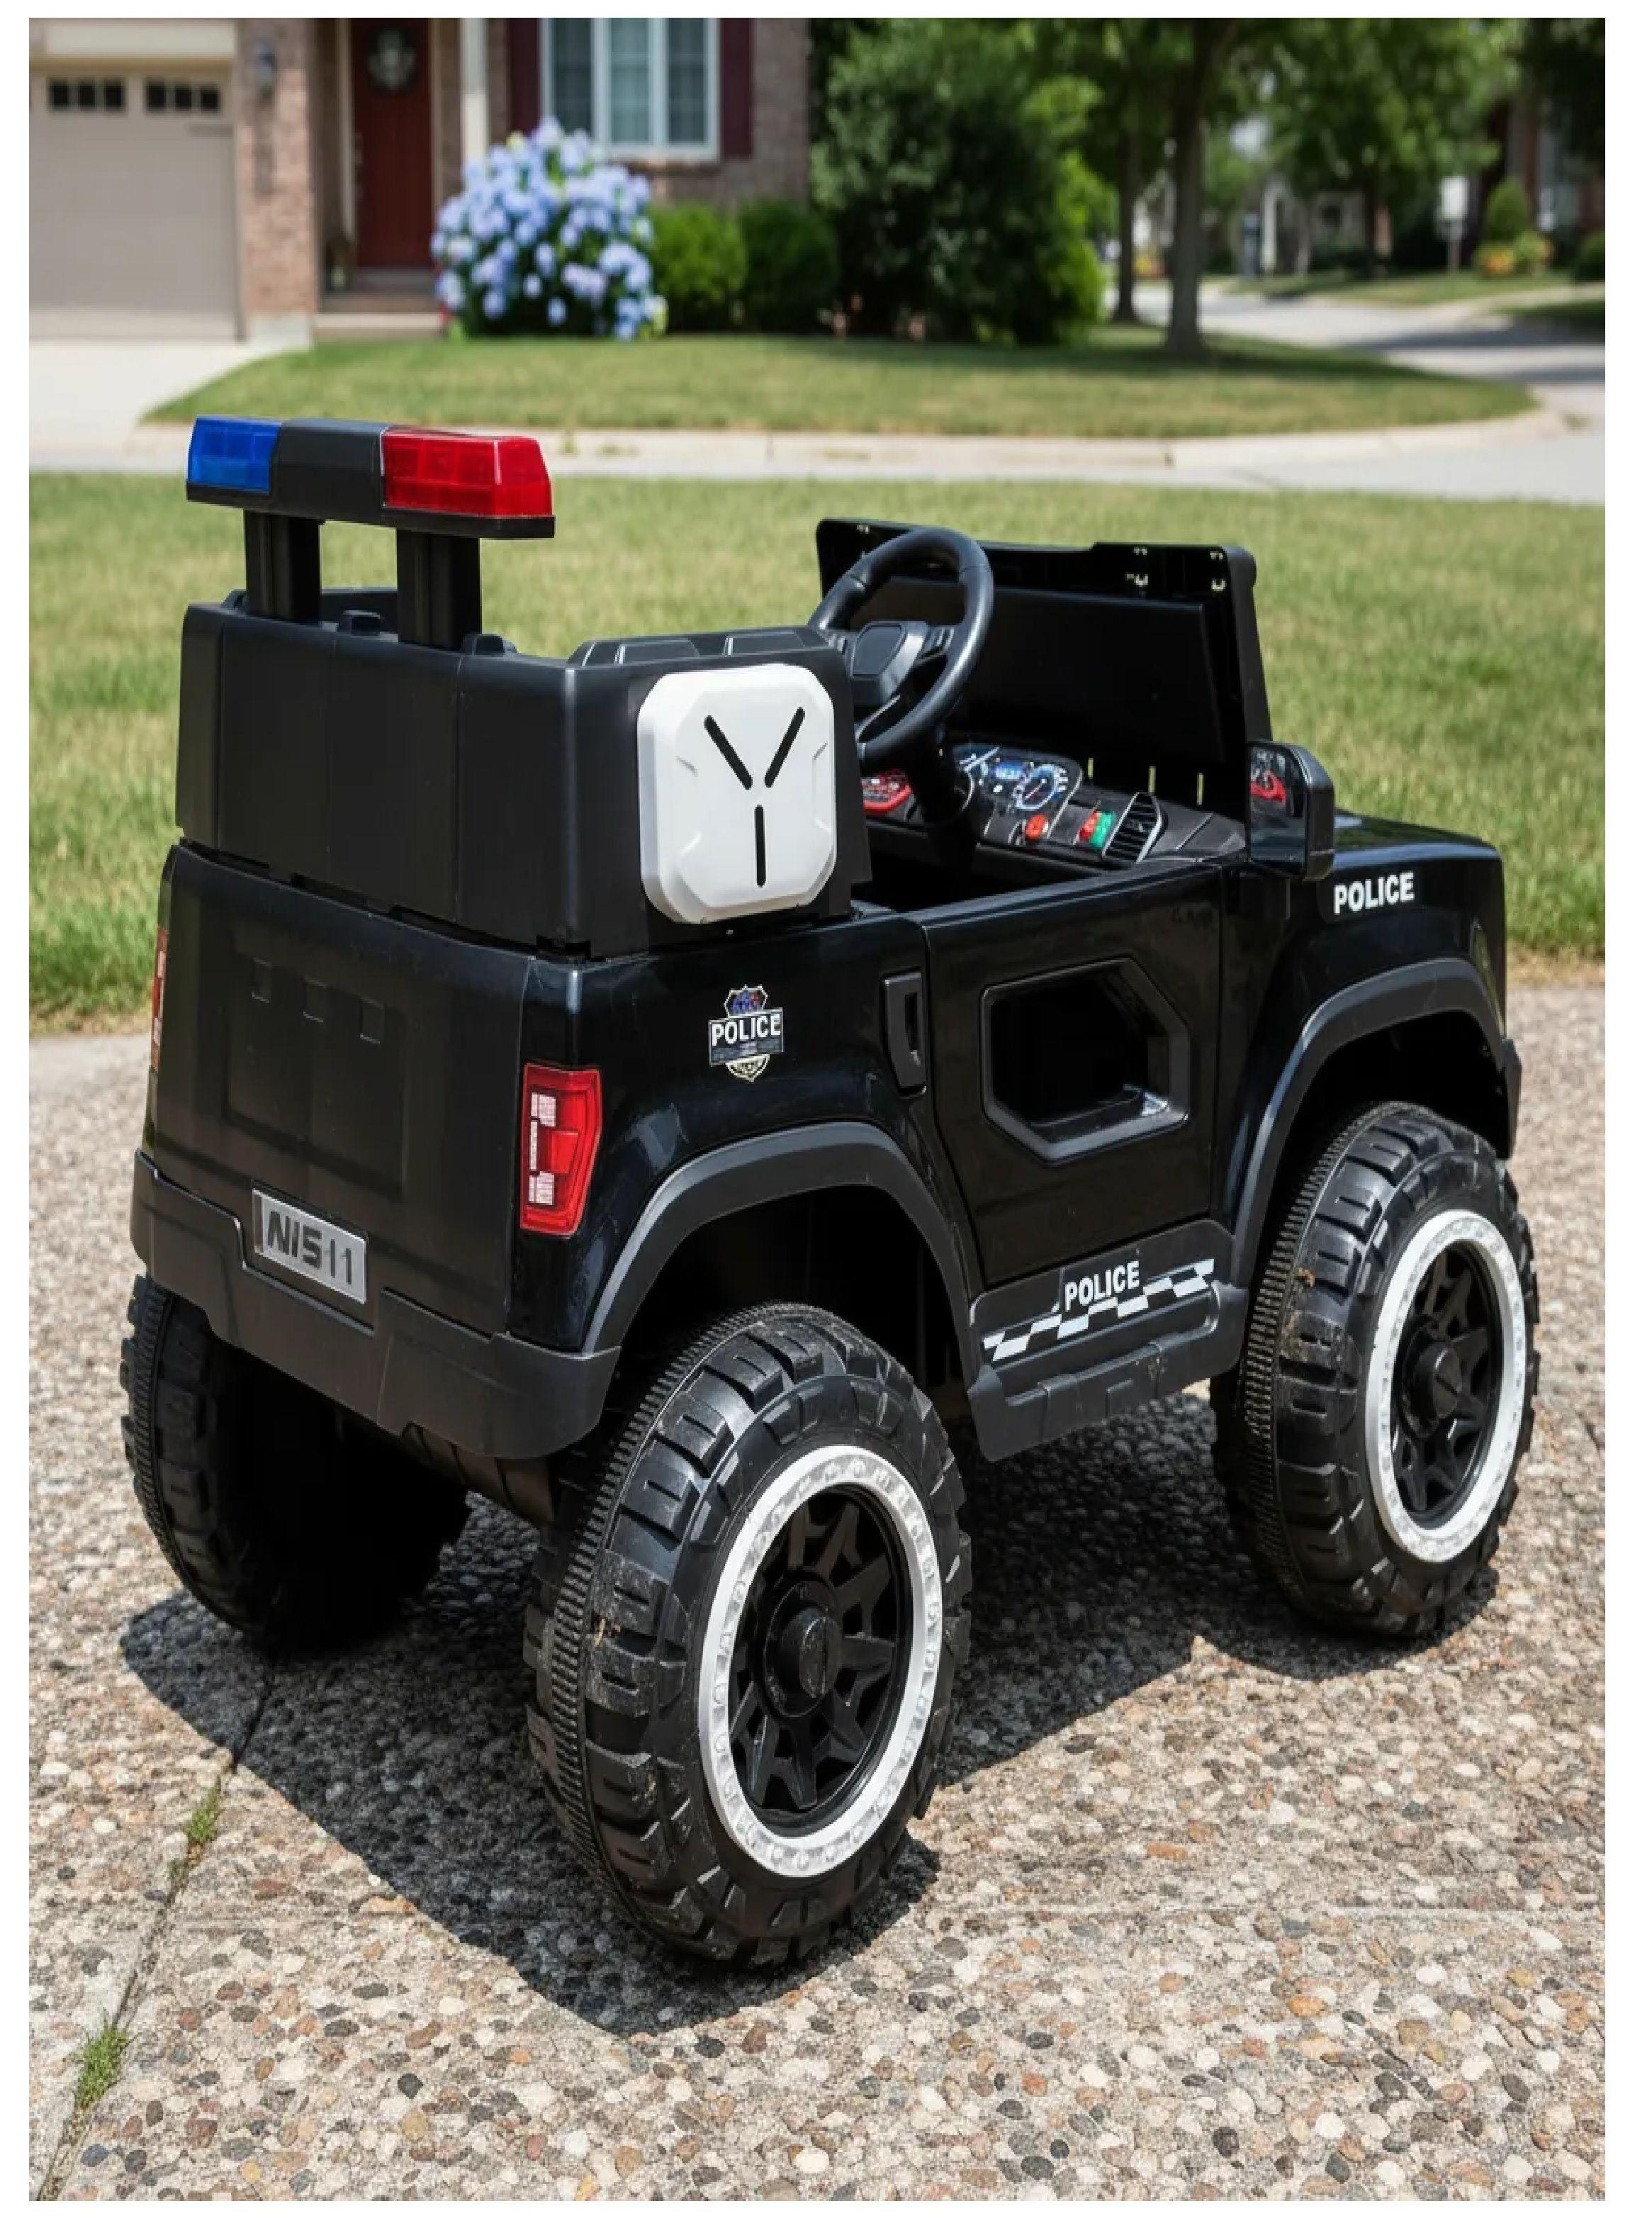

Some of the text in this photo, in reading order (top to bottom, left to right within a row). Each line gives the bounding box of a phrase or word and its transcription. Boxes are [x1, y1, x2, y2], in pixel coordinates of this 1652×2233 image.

[1334, 871, 1415, 915] POLICE
[712, 1013, 781, 1046] POLICE
[1064, 1260, 1140, 1311] POLICE
